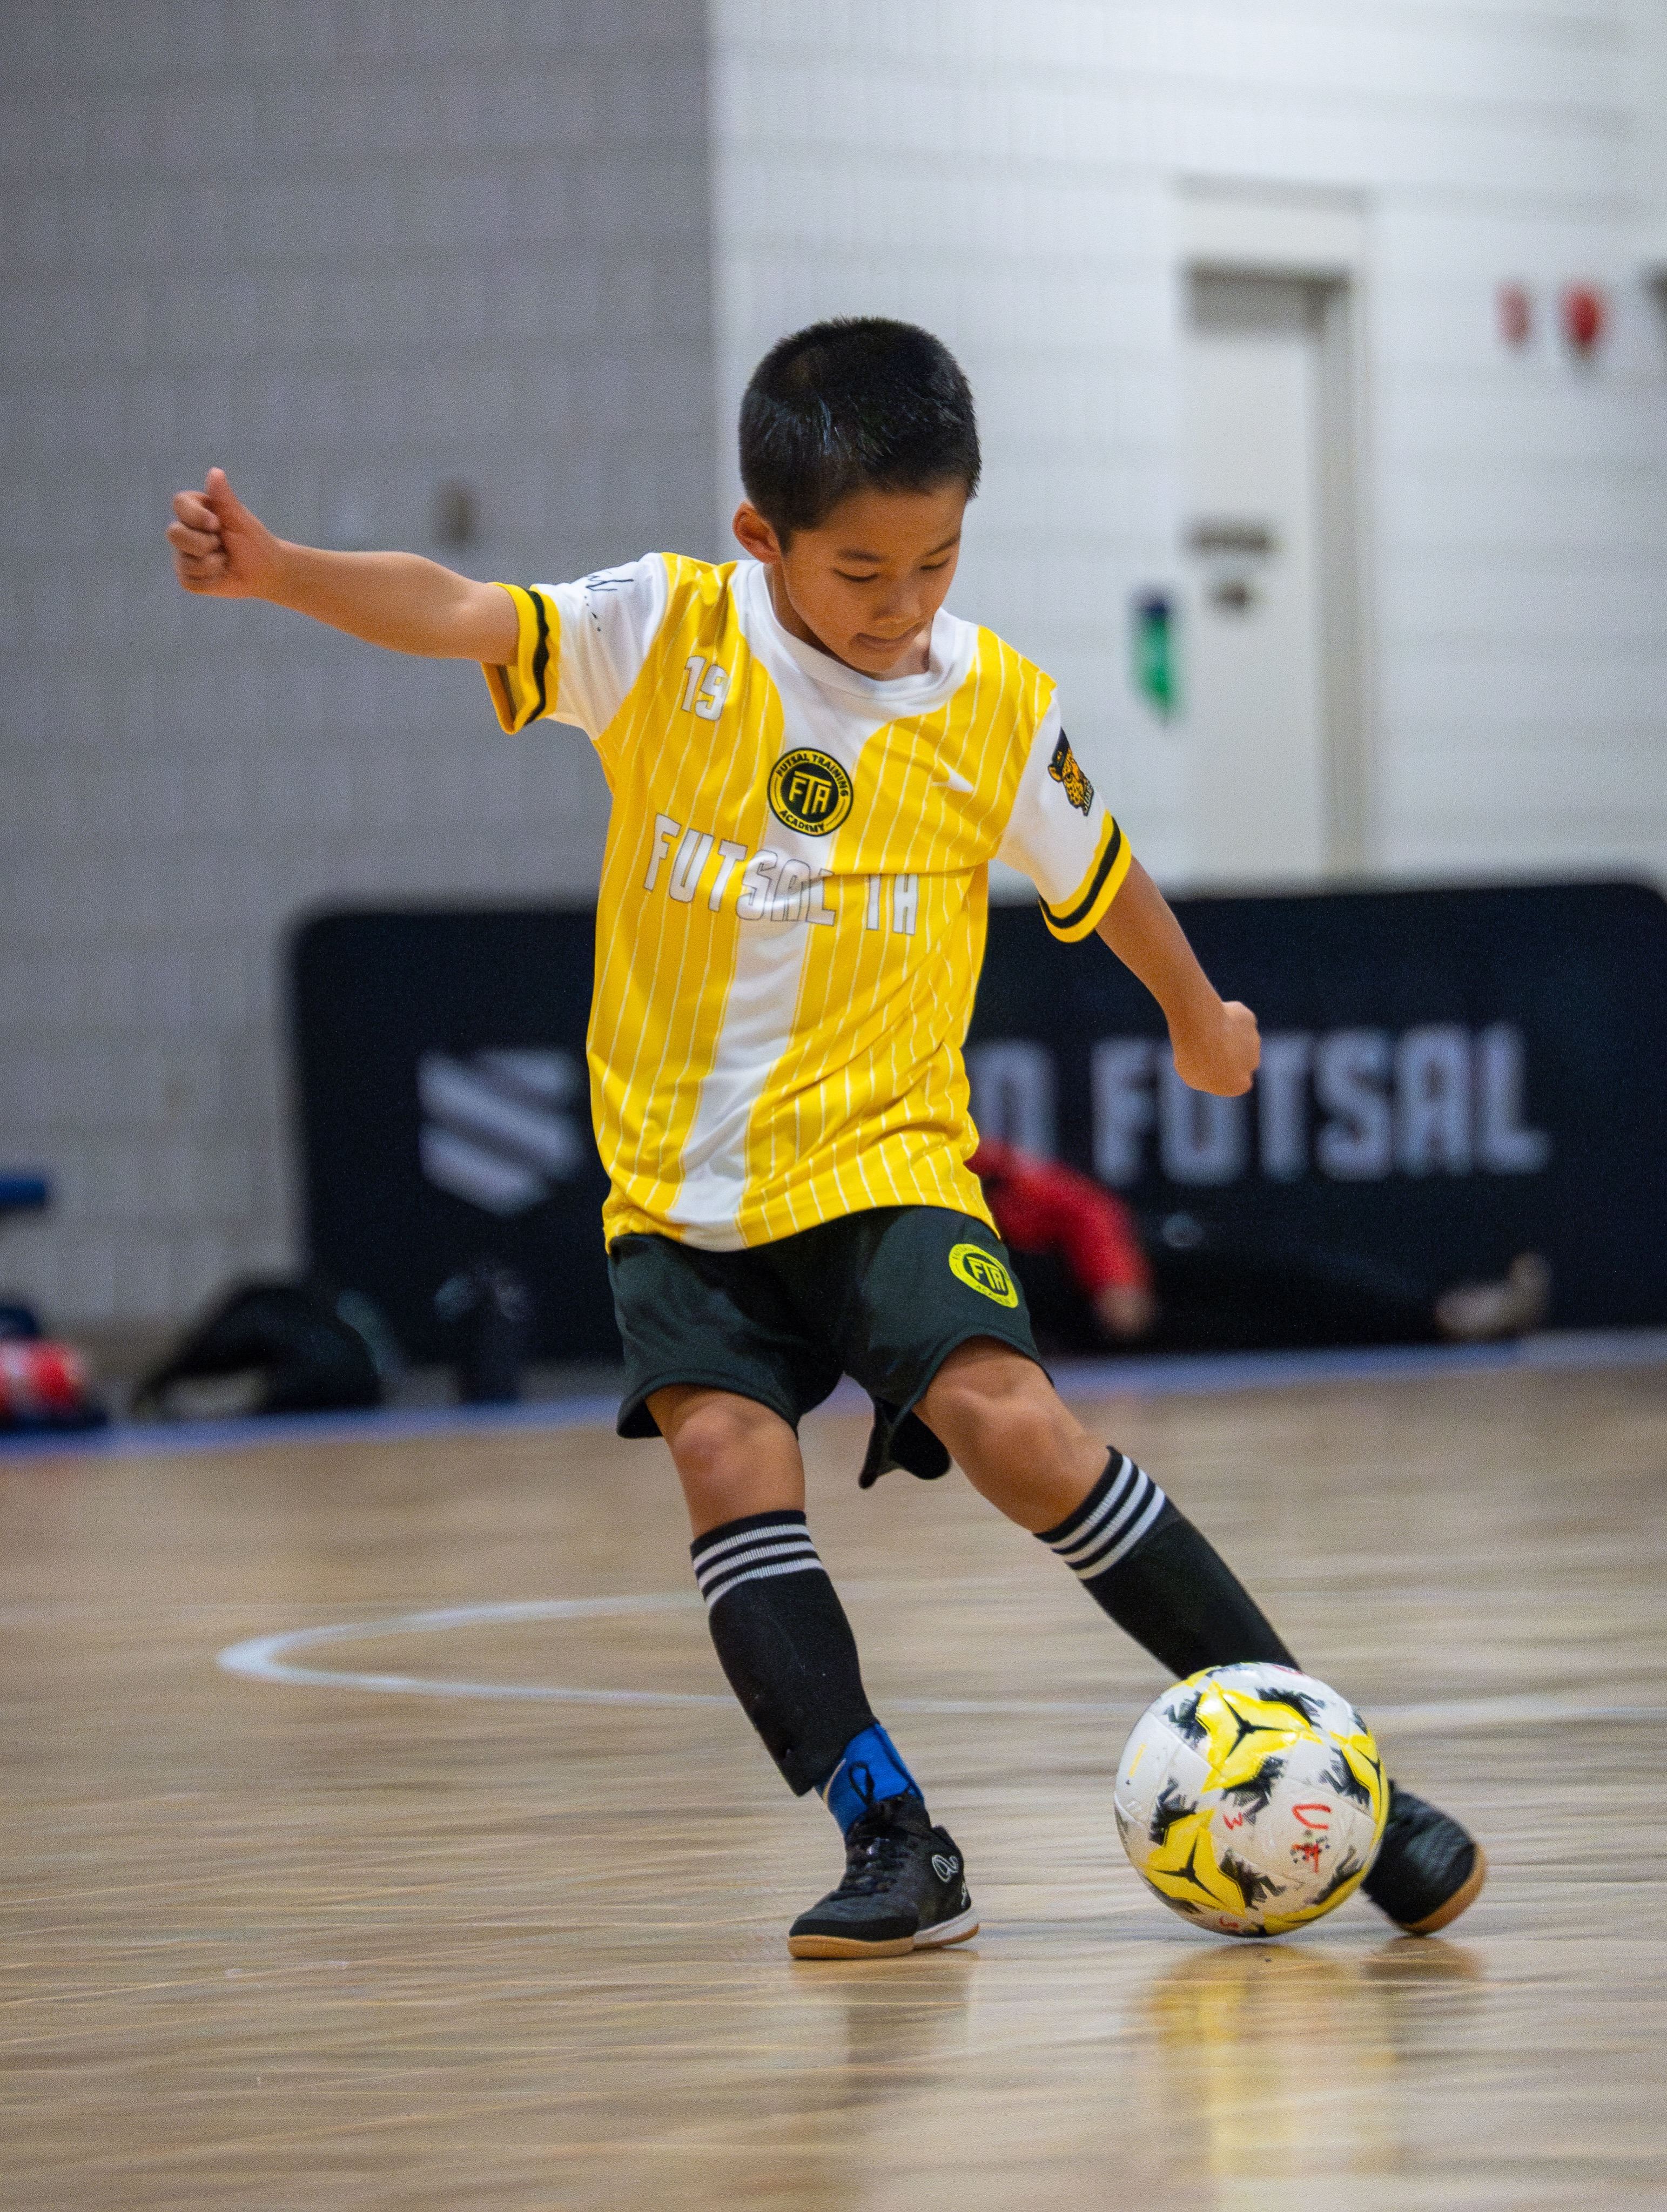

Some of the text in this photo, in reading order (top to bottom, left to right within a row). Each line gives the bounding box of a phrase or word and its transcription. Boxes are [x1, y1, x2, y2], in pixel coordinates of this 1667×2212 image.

[776, 753, 849, 797] FUTSAL TRAINING
[789, 771, 832, 814] FTA
[779, 810, 824, 832] ACADEMY
[643, 813, 836, 927] FUTSAL
[1088, 1022, 1551, 1185] FUTSAL
